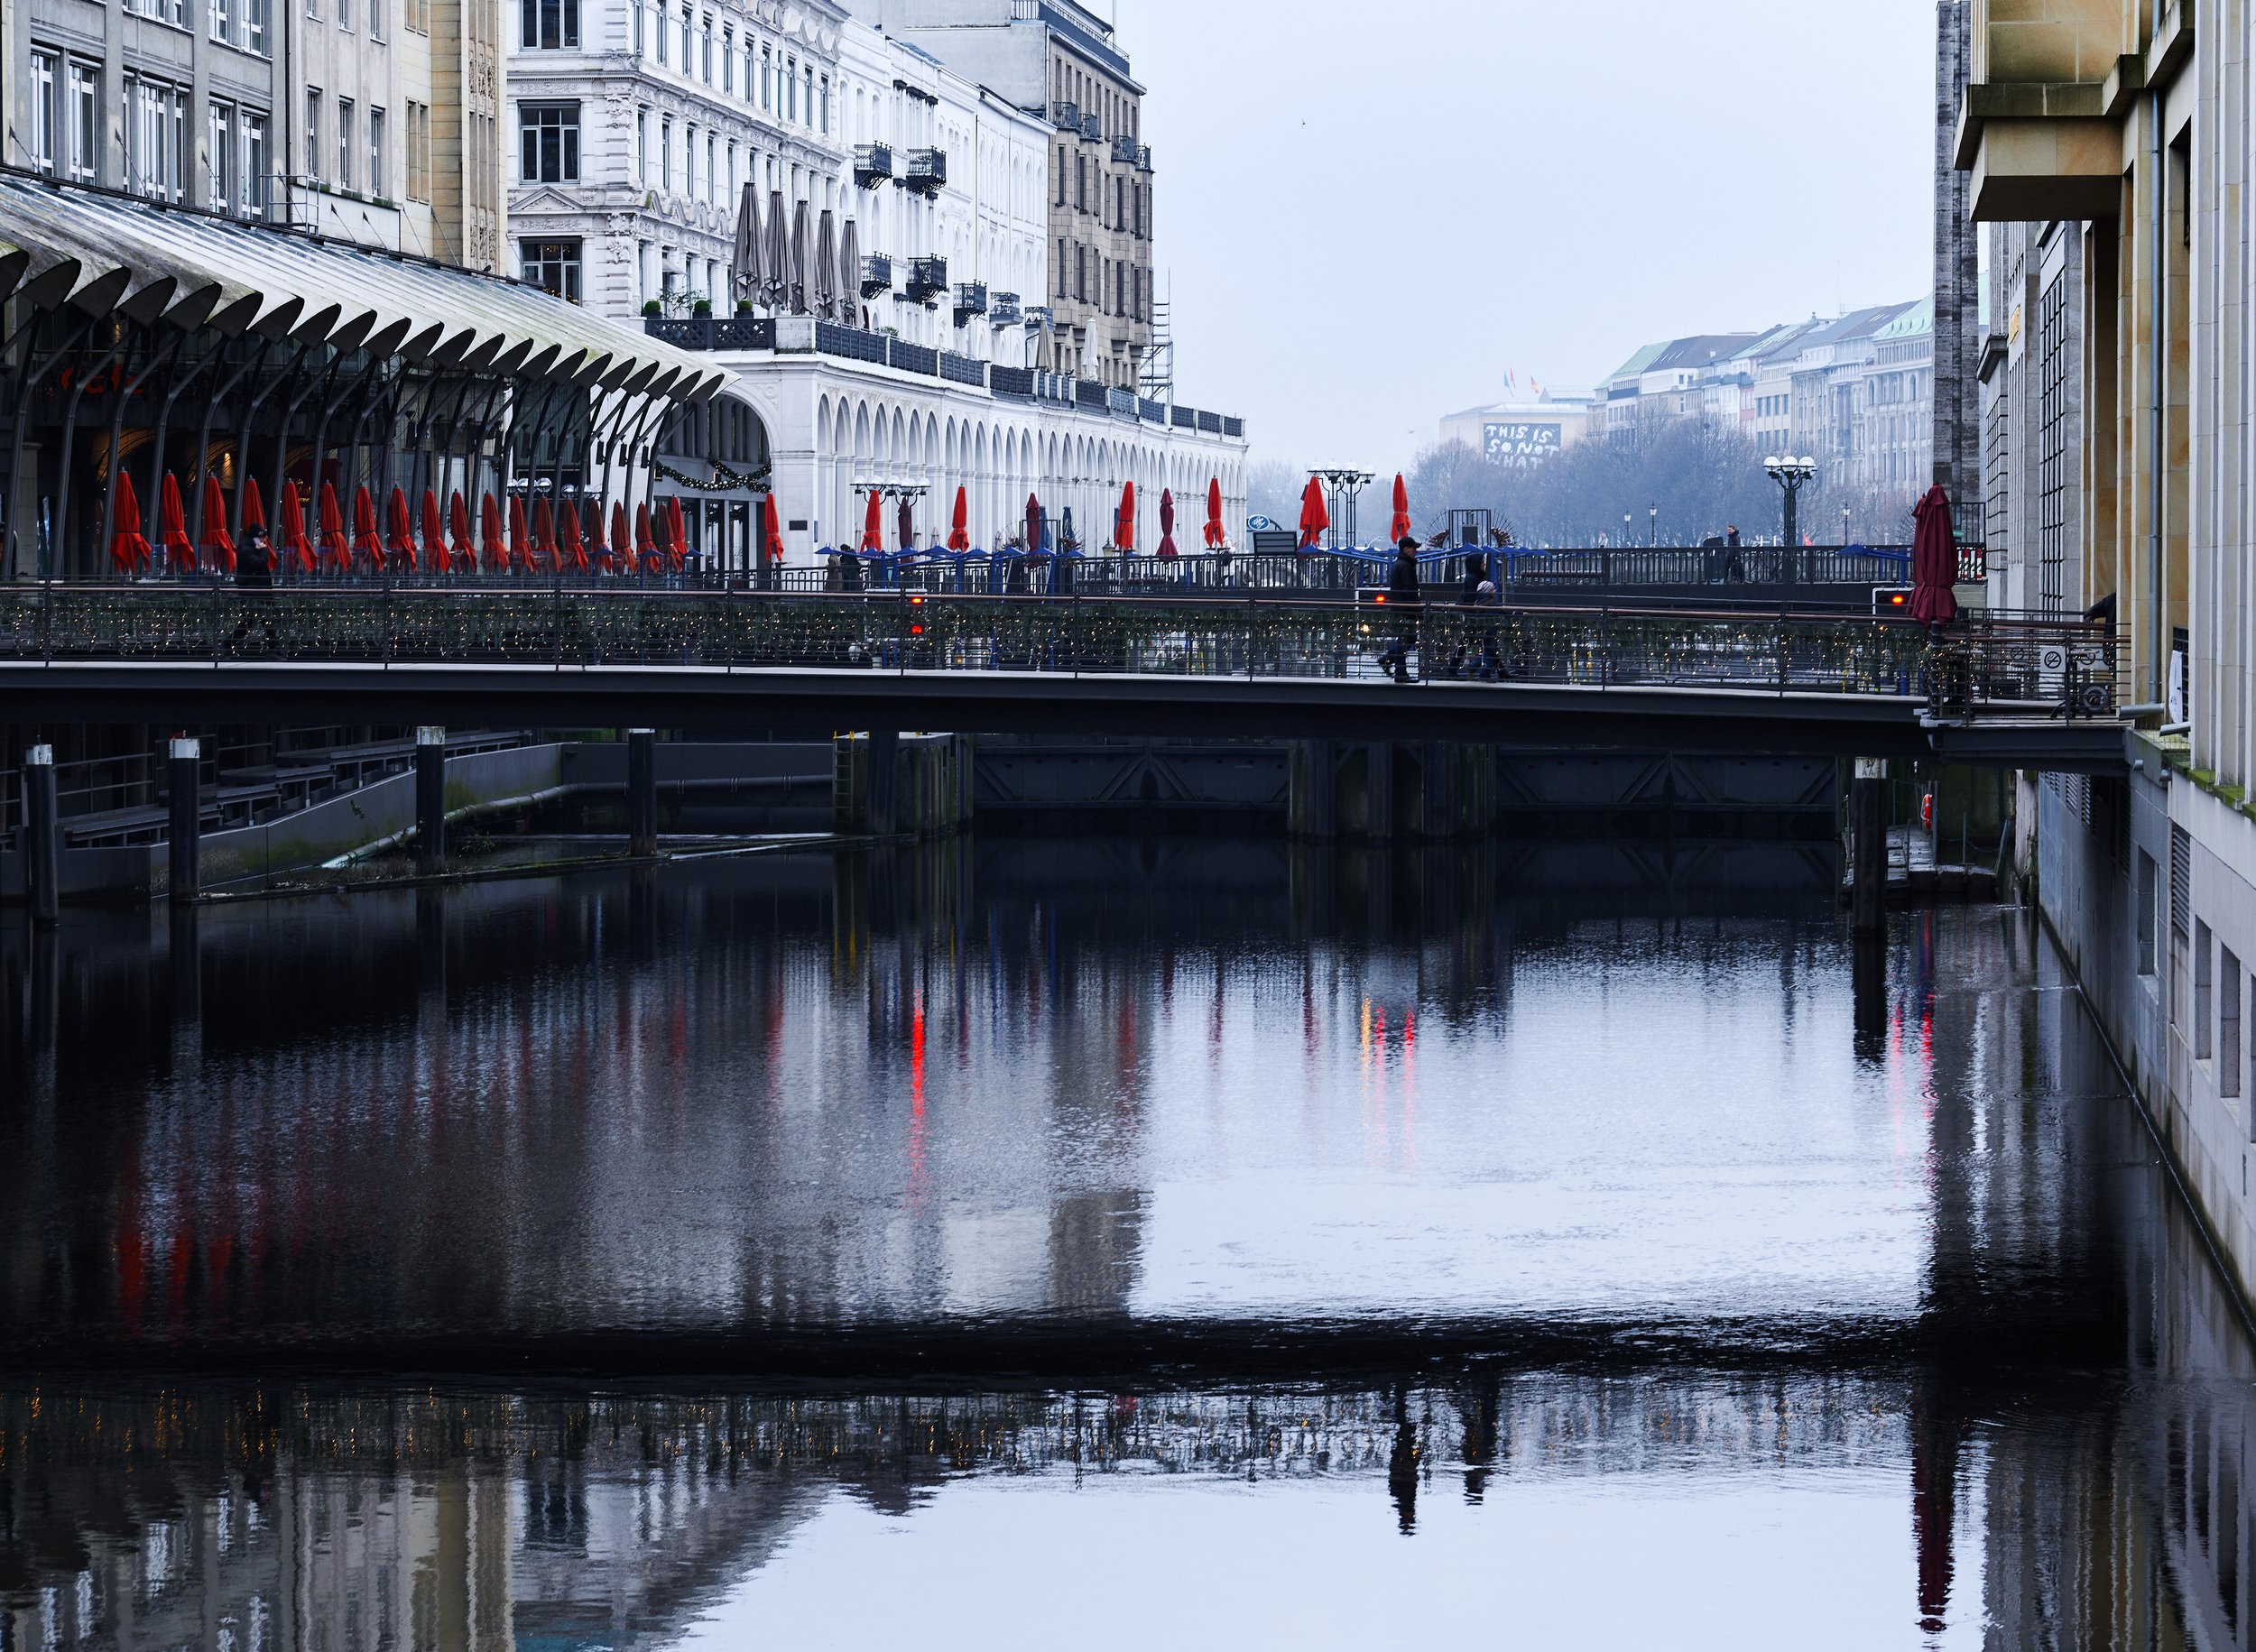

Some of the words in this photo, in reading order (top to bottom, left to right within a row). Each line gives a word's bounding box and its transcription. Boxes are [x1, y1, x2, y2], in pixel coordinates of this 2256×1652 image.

[1485, 425, 1529, 440] THIS
[1532, 429, 1553, 444] IS
[1487, 438, 1512, 453] SO
[1516, 442, 1559, 457] NOT
[1485, 453, 1543, 469] WHAT
